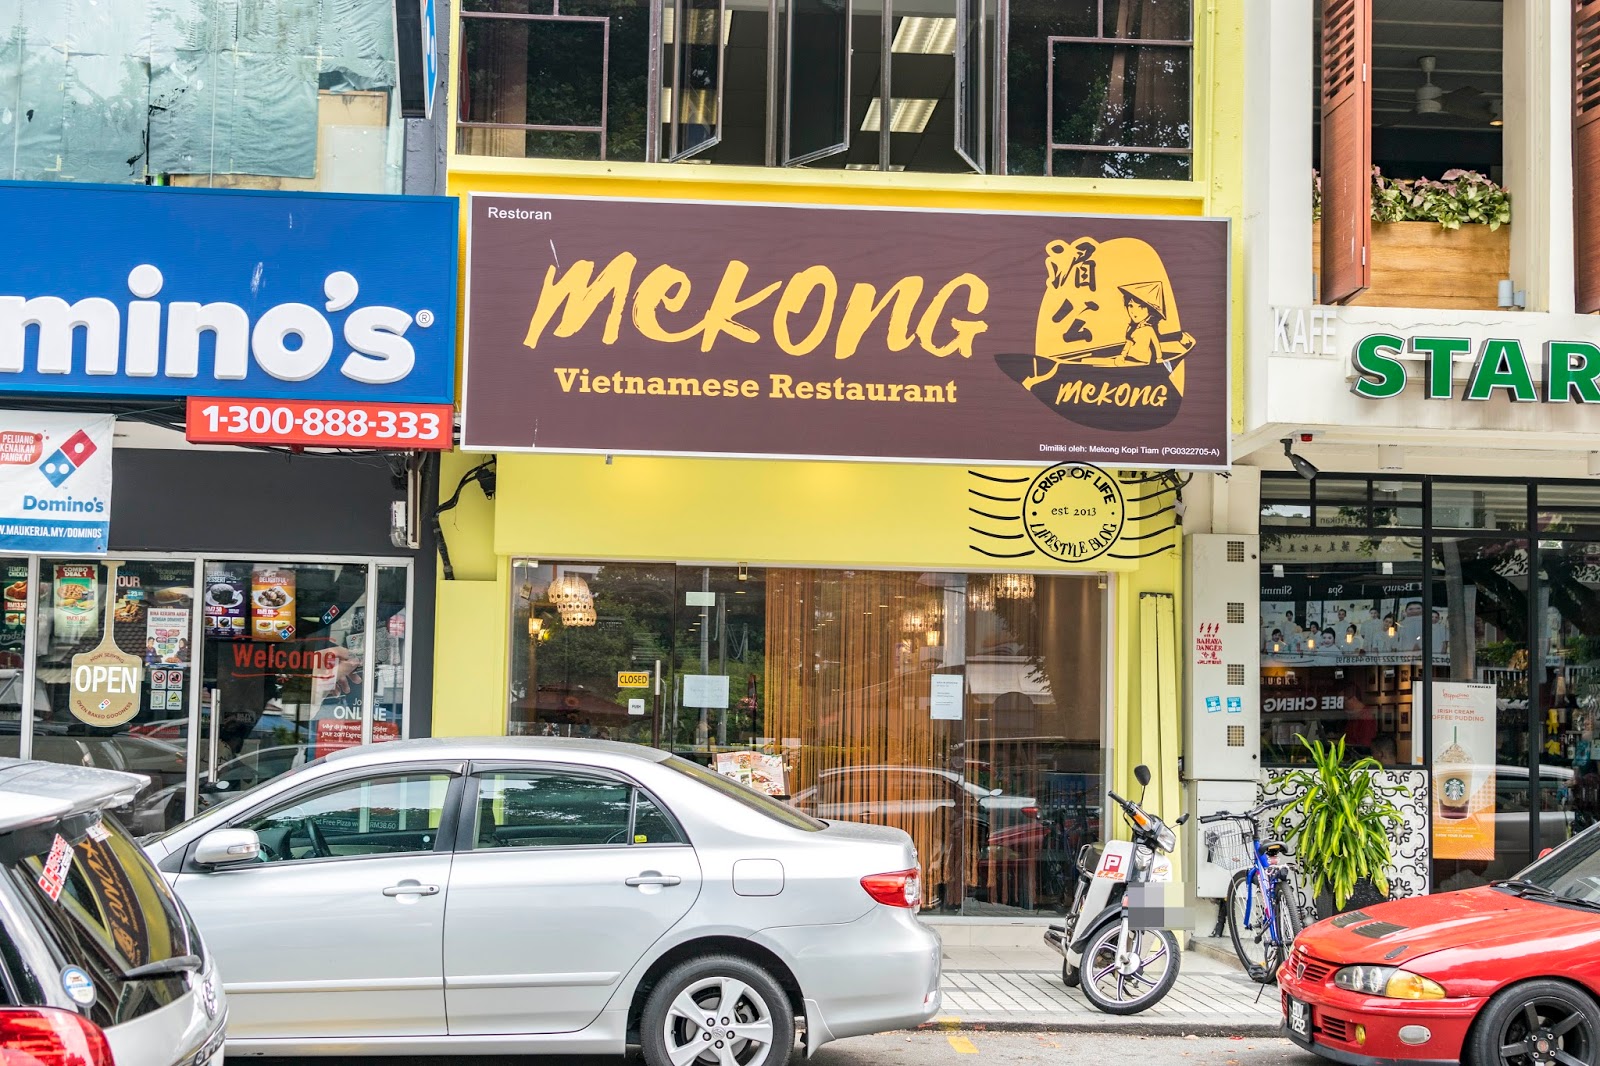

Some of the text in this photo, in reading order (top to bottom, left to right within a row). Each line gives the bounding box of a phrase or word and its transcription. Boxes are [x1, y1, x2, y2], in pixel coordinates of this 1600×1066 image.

[487, 206, 552, 221] Restoran
[1272, 308, 1337, 355] KAFE
[1350, 333, 1600, 405] STAR
[555, 368, 957, 404] Vietnamese Restaurant
[202, 404, 441, 442] 1-300-888-333
[2, 434, 34, 444] PELUANG
[0, 444, 36, 453] KENAIKAN
[1039, 443, 1220, 457] Dimiliki oleh: Mekong Kopi Tiam (PG0322705-A)
[1, 453, 32, 462] PANGKAT
[23, 495, 104, 513] Domino's
[232, 643, 336, 671] Welcome
[75, 664, 138, 694] OPEN
[619, 675, 648, 684] CLOSED
[76, 699, 88, 713] OVEN
[87, 710, 106, 720] BAKED
[333, 705, 387, 722] ONLNE
[322, 818, 336, 826] Free
[336, 819, 352, 827] Pizza
